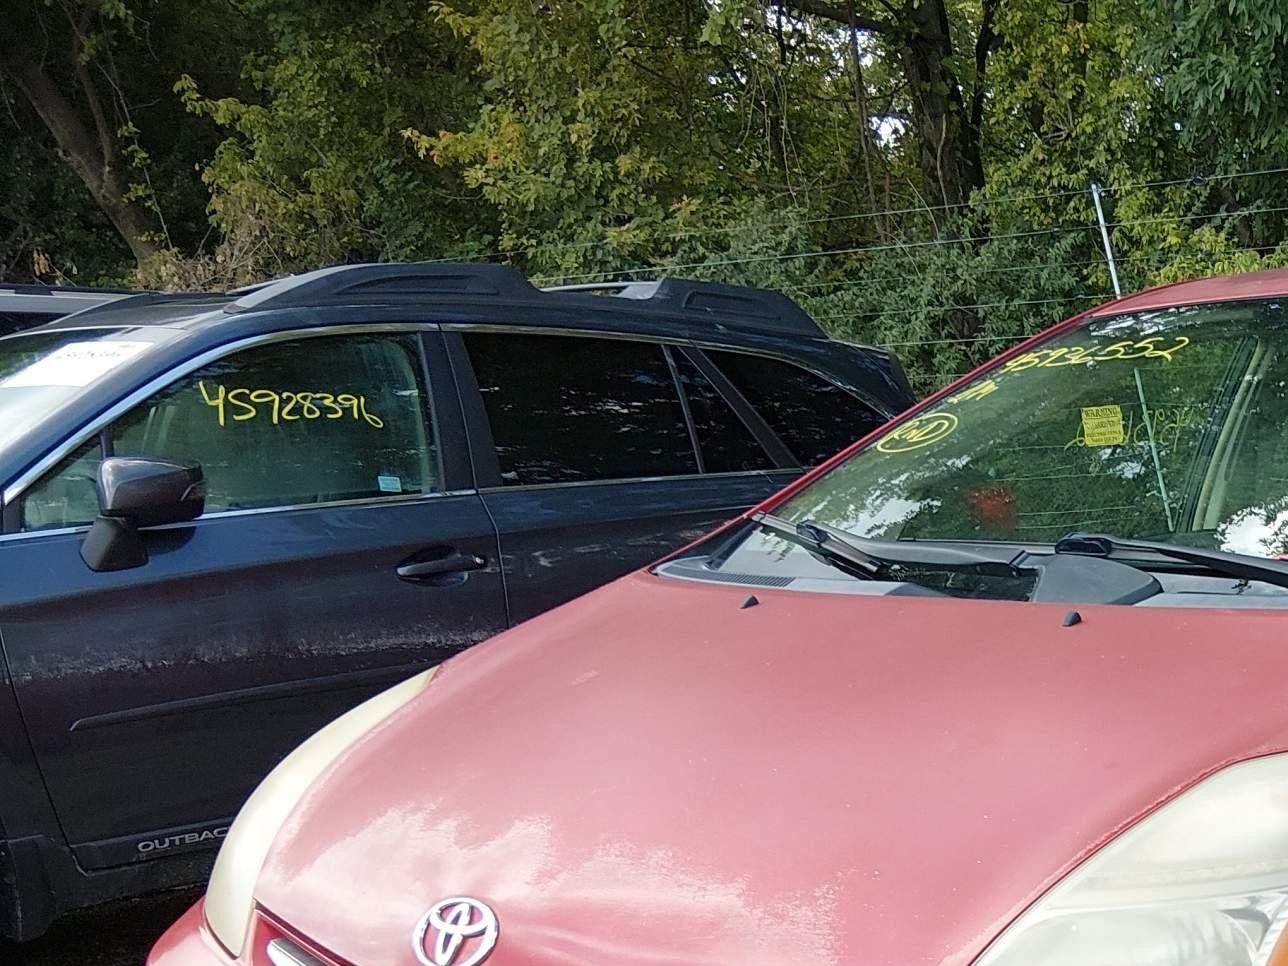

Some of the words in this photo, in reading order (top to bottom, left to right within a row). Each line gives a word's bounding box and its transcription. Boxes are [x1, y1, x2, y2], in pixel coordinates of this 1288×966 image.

[199, 381, 384, 428] 45928396
[1083, 406, 1119, 418] WARNING
[137, 826, 231, 852] OUTBAC
